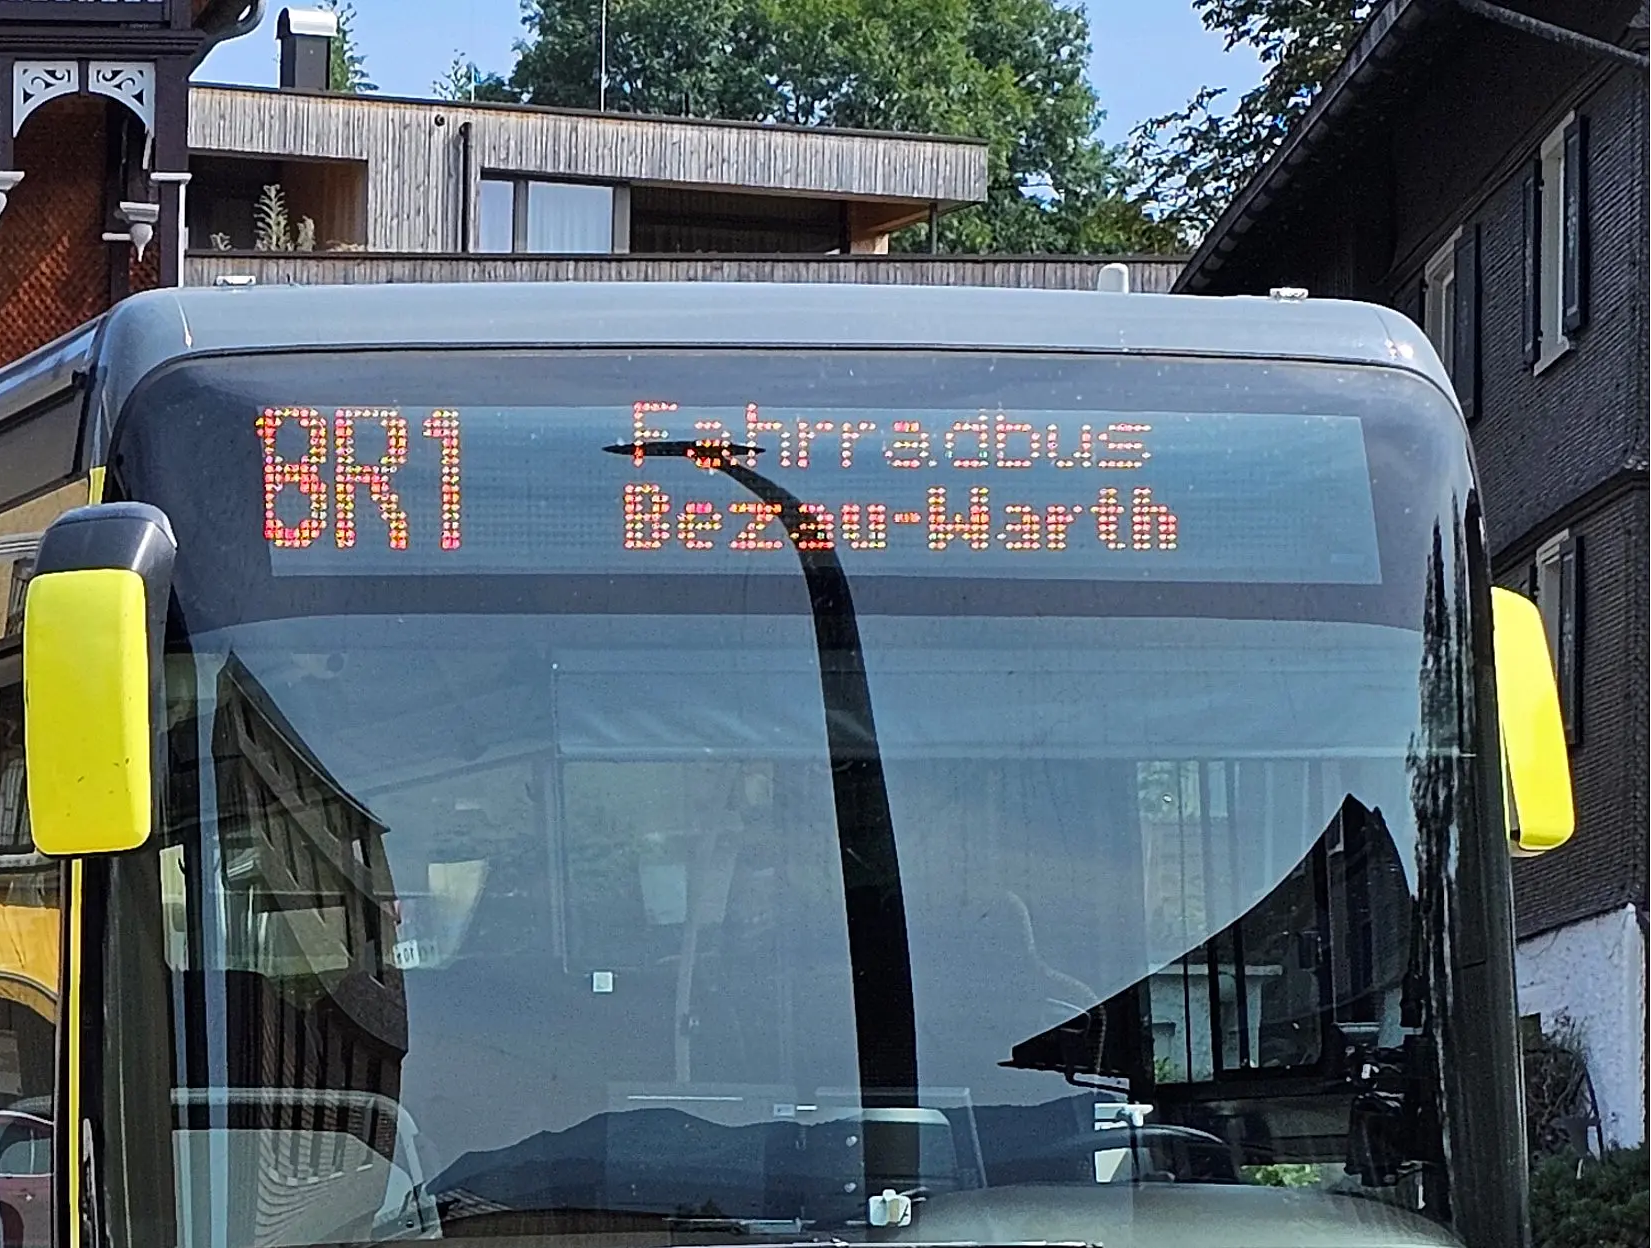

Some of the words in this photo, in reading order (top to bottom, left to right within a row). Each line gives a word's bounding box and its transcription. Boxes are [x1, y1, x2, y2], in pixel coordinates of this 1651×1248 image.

[255, 407, 461, 550] BR1
[630, 400, 1153, 469] Fahrradbus
[622, 483, 1176, 551] Bezau-Warth
